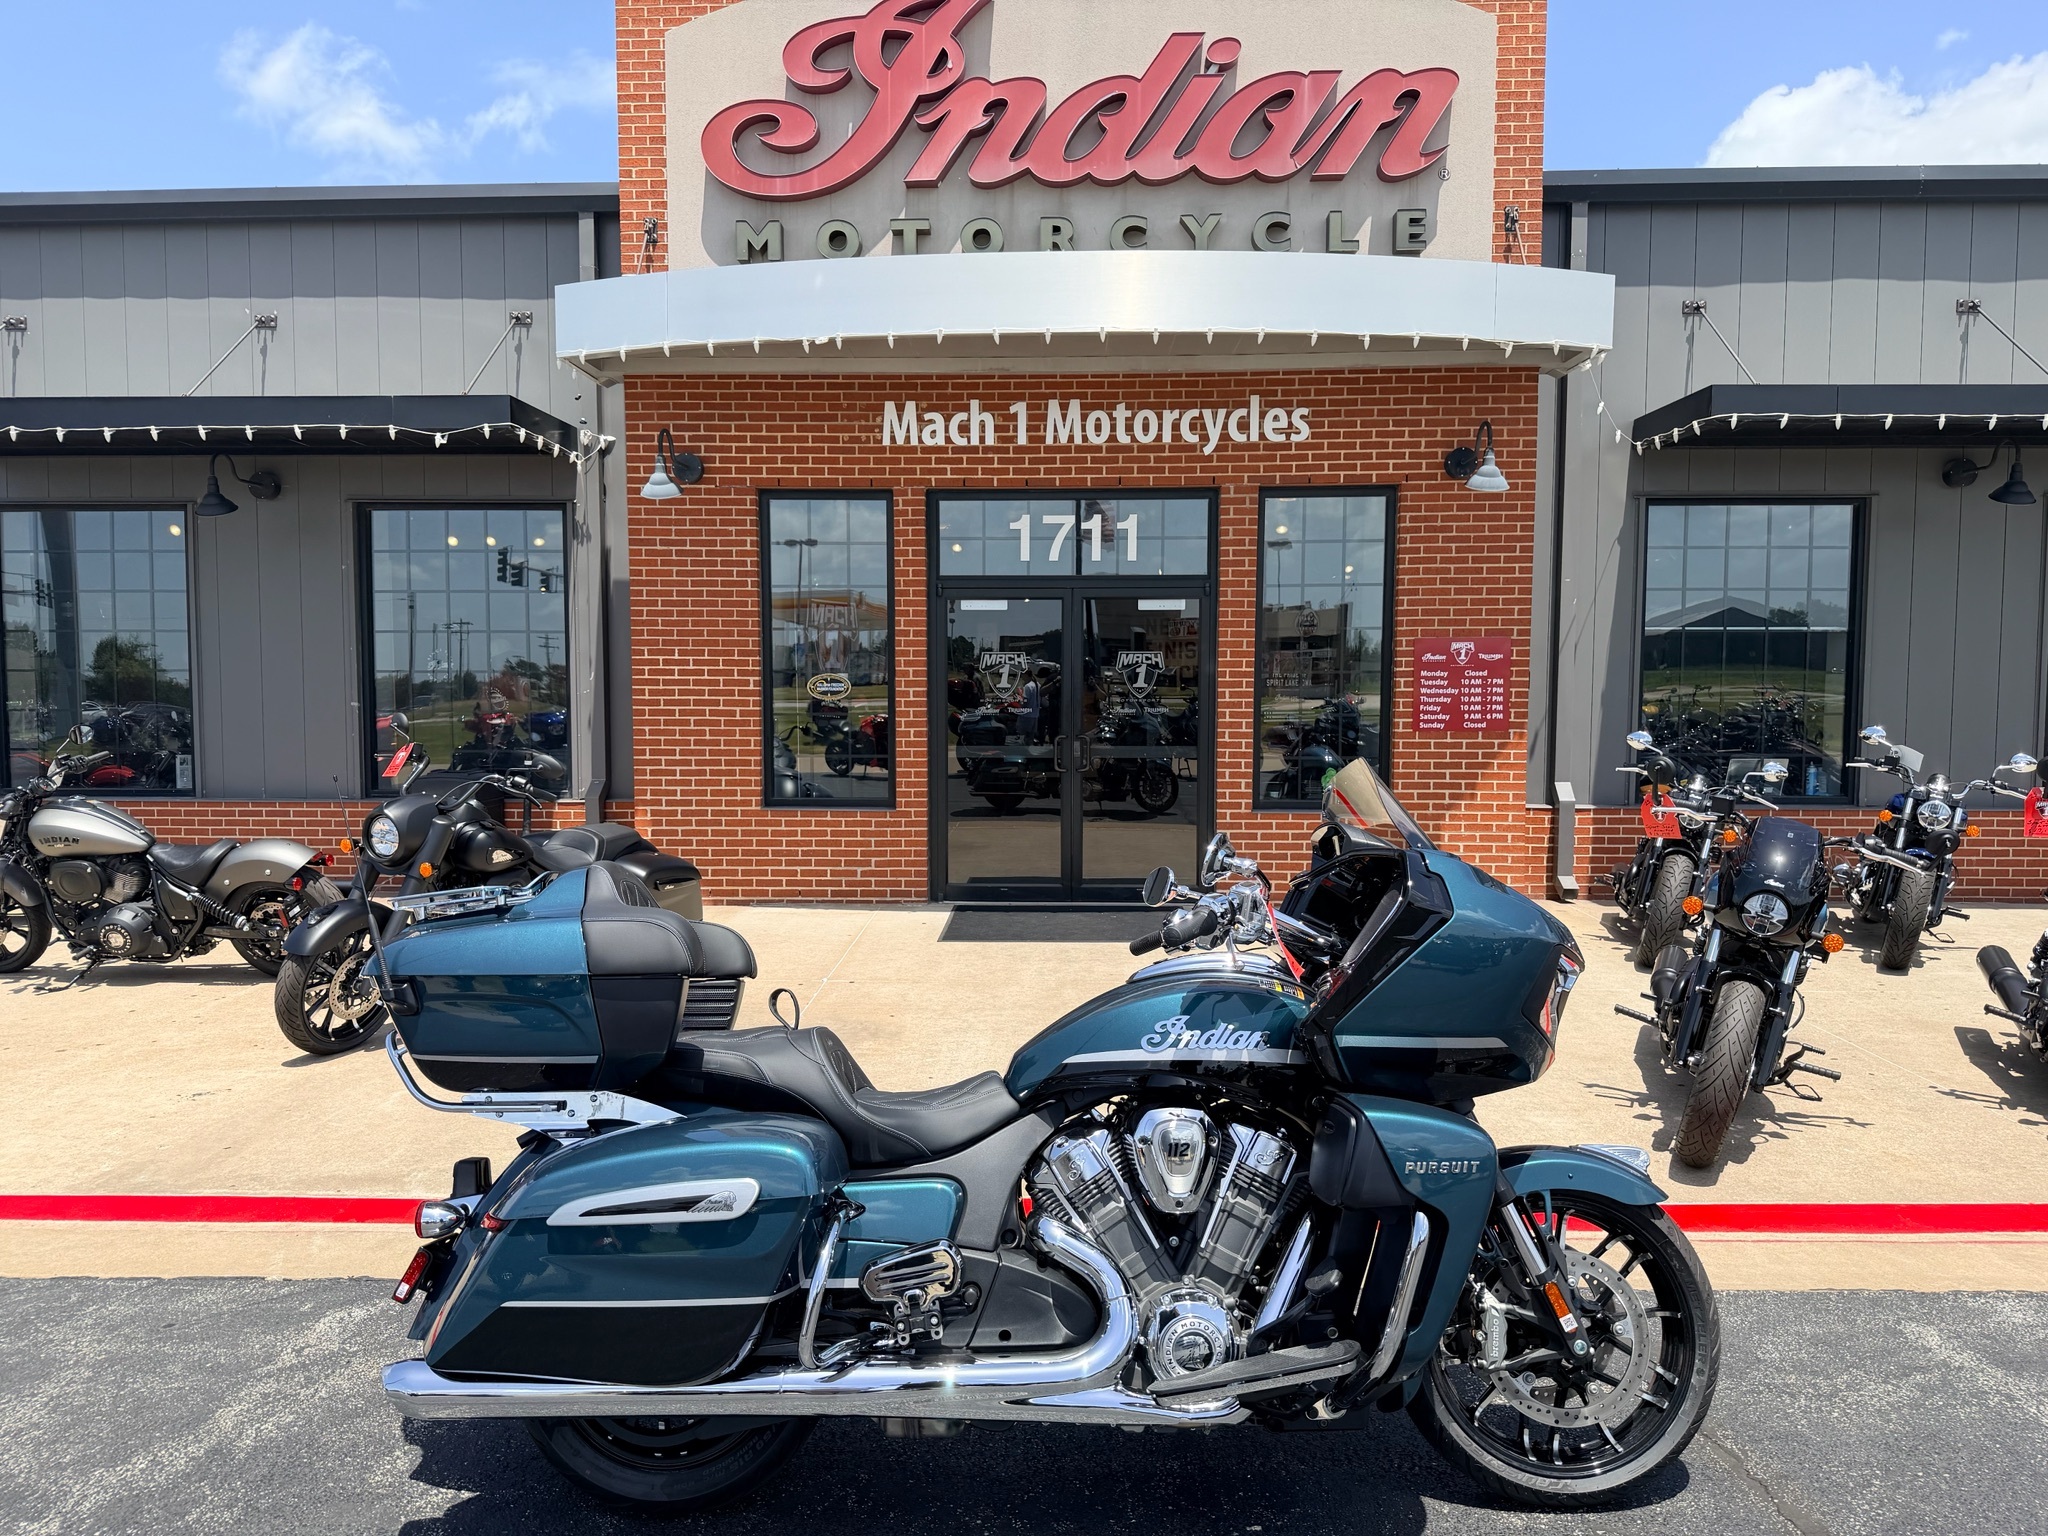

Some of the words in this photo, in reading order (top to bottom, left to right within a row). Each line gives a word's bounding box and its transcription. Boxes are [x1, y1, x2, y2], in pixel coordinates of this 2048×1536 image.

[700, 0, 1460, 201] Indian
[735, 208, 1428, 263] MOTORCYCLE
[882, 398, 995, 446] Mach
[1009, 400, 1028, 446] 1
[1045, 394, 1311, 456] Motorcycles
[1009, 513, 1138, 562] 1711
[982, 654, 1026, 669] MACH
[1119, 653, 1163, 669] MACH
[996, 664, 1012, 688] 1
[1132, 663, 1148, 688] 1
[1420, 713, 1450, 721] Saturday
[38, 836, 80, 845] INDIAN
[1141, 1014, 1271, 1053] Indian
[1167, 1142, 1191, 1158] 112
[1404, 1160, 1480, 1174] PURSUIT
[1165, 1329, 1178, 1370] INDIAN
[1180, 1321, 1223, 1367] MOTORCYCL
[1490, 1318, 1500, 1358] brembo
